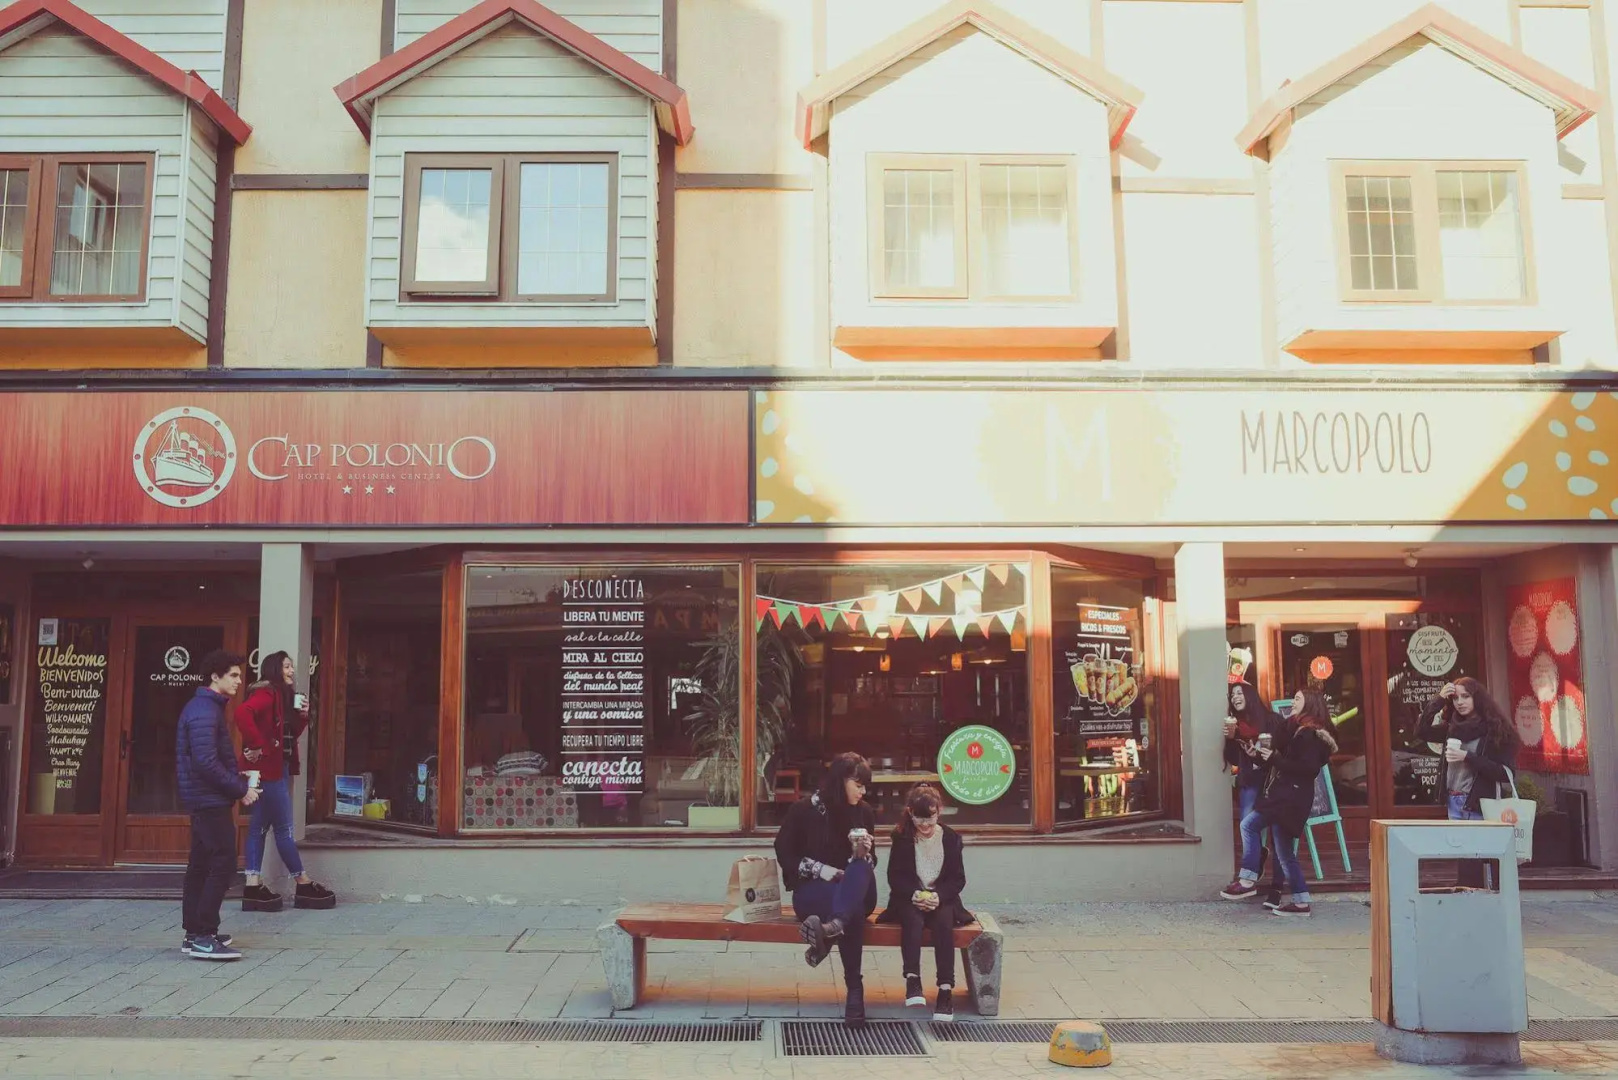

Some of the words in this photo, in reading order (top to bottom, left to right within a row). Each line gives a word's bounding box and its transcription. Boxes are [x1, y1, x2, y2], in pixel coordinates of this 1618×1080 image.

[1240, 410, 1431, 474] MARCOPOLO
[247, 433, 321, 480] CAP
[330, 436, 496, 480] POLONIO
[1045, 402, 1113, 503] M
[297, 472, 331, 480] HOTEL
[348, 472, 396, 480] BUSINESS
[401, 472, 441, 480] CENTER
[563, 579, 644, 599] DESCONECTA
[563, 611, 597, 622] LIBERA
[598, 611, 610, 622] TU
[612, 611, 644, 622] MENTE
[564, 631, 587, 642] sal
[588, 634, 597, 642] a
[598, 631, 612, 642] la
[612, 631, 643, 642] calle
[38, 643, 107, 667] Welcome
[1408, 646, 1458, 655] momento
[562, 652, 589, 663] MIRA
[593, 652, 608, 663] AL
[612, 652, 644, 663] CIELO
[1317, 662, 1326, 673] M
[40, 668, 104, 684] BIENVENIDOS
[150, 673, 165, 681] CAP
[563, 671, 594, 681] disfruta
[595, 671, 605, 680] de
[606, 671, 615, 680] la
[616, 671, 644, 680] belleza
[41, 682, 100, 698] Bem-vindo
[563, 680, 581, 691] del
[584, 680, 618, 691] mundo
[620, 680, 643, 692] real
[44, 699, 97, 712] Benvenuti
[562, 701, 603, 709] INTERCAMBIA
[604, 701, 618, 709] UNA
[619, 701, 643, 709] MIRADA
[562, 710, 573, 723] y
[574, 710, 598, 719] una
[600, 708, 644, 719] sonrisa
[562, 734, 593, 747] RECUPERA
[594, 734, 603, 747] TU
[604, 734, 625, 747] TIEMPO
[626, 734, 644, 747] LIBRE
[971, 745, 979, 755] M
[562, 756, 644, 775] conecta
[953, 761, 999, 776] MARCOPOLO
[562, 773, 603, 788] contigo
[605, 773, 643, 784] mismo
